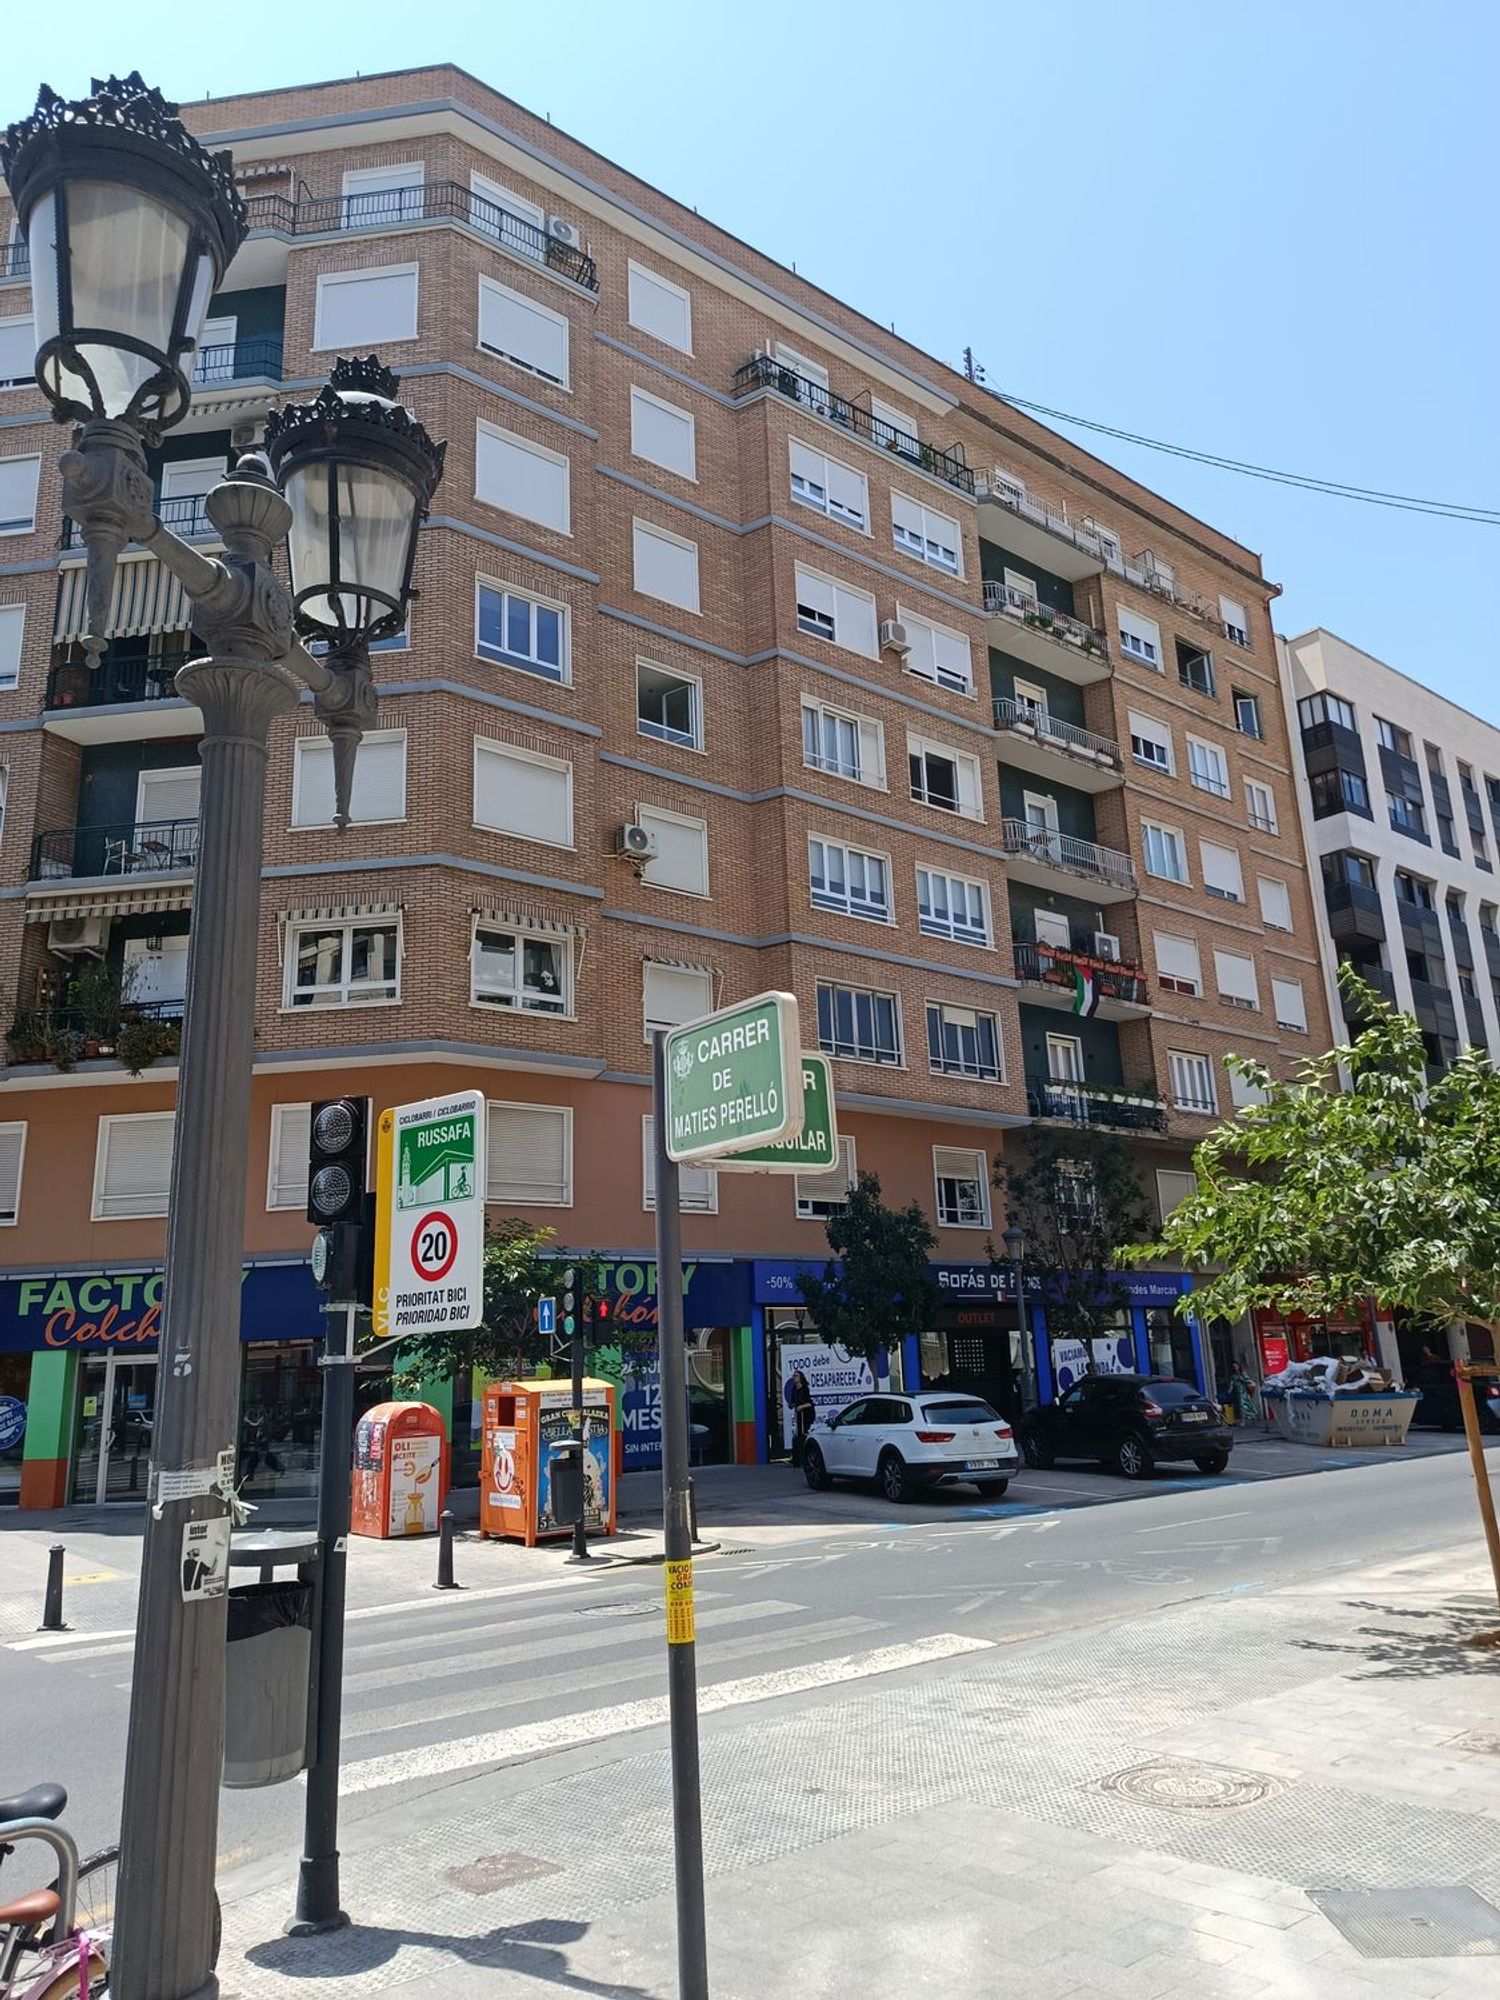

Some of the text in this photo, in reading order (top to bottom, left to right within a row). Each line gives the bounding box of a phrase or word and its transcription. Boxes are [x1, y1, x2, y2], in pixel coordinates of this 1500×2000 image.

[698, 1019, 770, 1063] CARRER
[712, 1068, 733, 1091] DE
[399, 1110, 432, 1125] CICLOBARRI
[437, 1101, 476, 1117] CICLOBARRIO
[675, 1081, 778, 1138] MATIES PERELLÓ
[417, 1122, 471, 1148] RUSSAFA
[421, 1231, 447, 1262] 20
[766, 1276, 794, 1290] -50%
[1149, 1284, 1178, 1295] Marcas
[18, 1274, 167, 1316] FACTO
[396, 1287, 467, 1308] PRIORITAT BICI
[377, 1287, 390, 1331] VLC
[395, 1305, 470, 1326] PRIORIDAD BICI
[958, 1312, 994, 1324] OUTLET
[45, 1304, 163, 1347] Colch
[788, 1355, 831, 1371] TODO debe
[622, 1408, 662, 1431] MES
[395, 1442, 411, 1452] OLI
[624, 1443, 638, 1454] SIN
